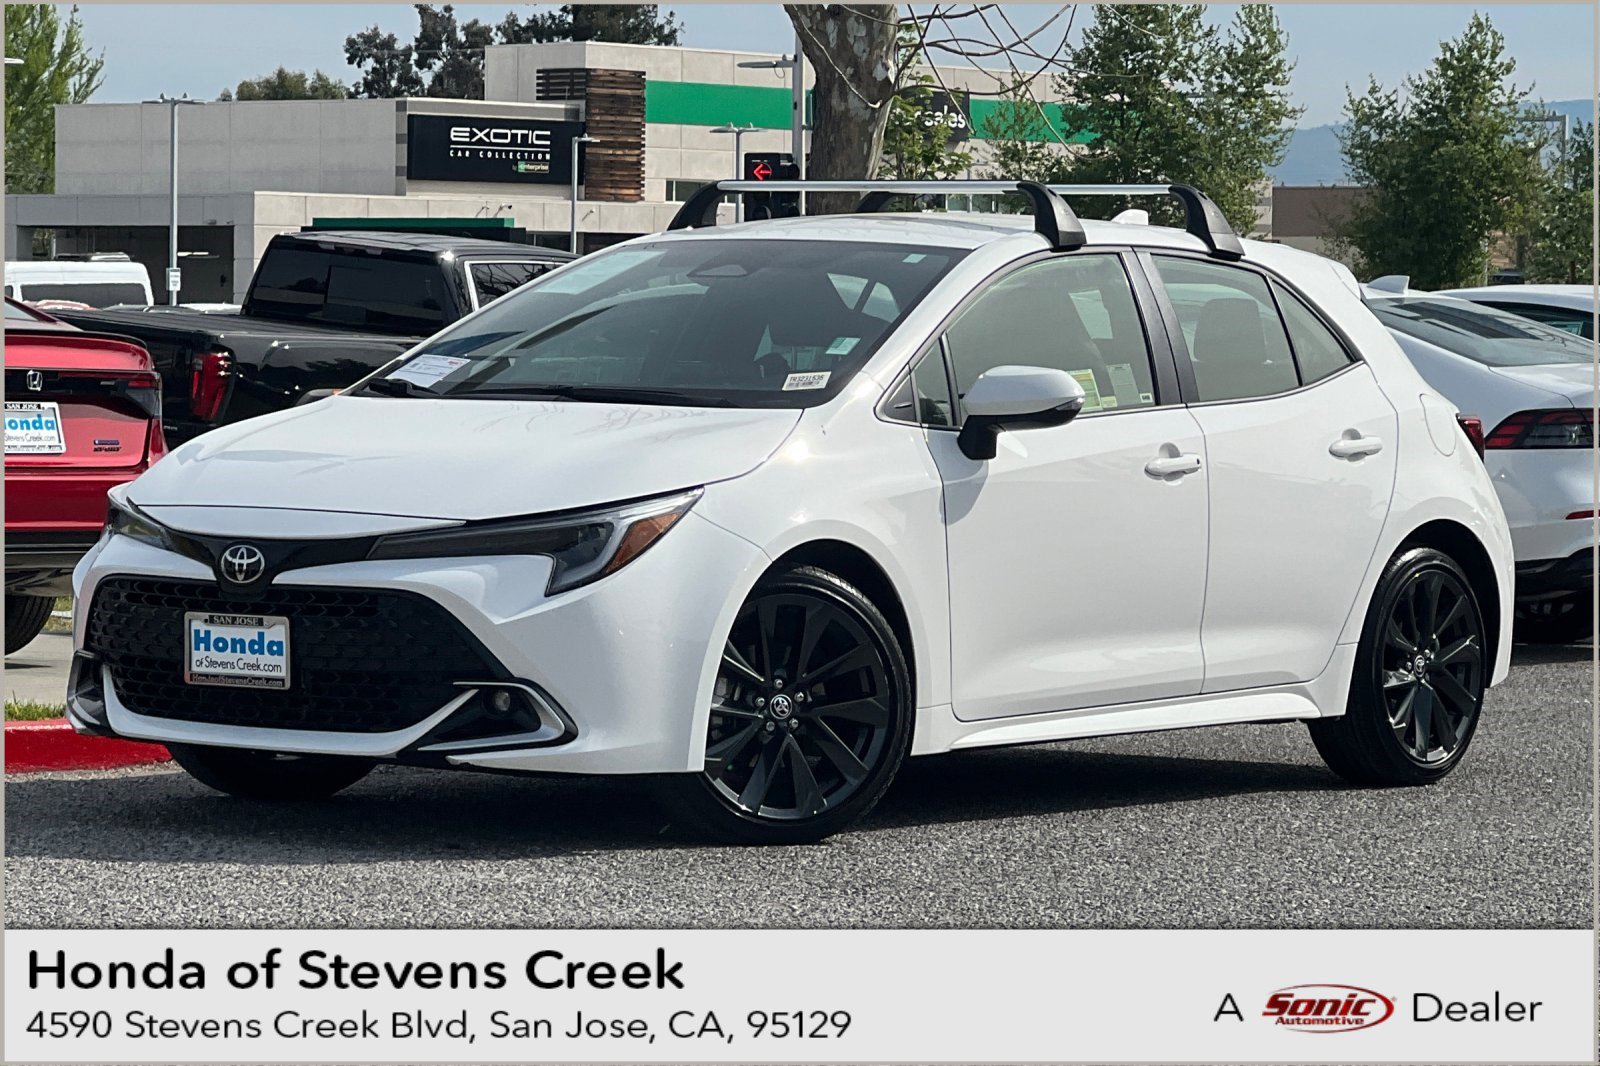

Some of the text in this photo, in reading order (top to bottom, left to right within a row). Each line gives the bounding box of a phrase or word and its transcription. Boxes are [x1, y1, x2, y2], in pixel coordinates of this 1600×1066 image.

[450, 127, 551, 145] EXOTIC
[479, 151, 551, 160] COLLECTION
[5, 414, 56, 430] onda
[213, 615, 259, 625] SAN JOSE
[193, 629, 284, 656] Honda
[195, 658, 203, 667] of
